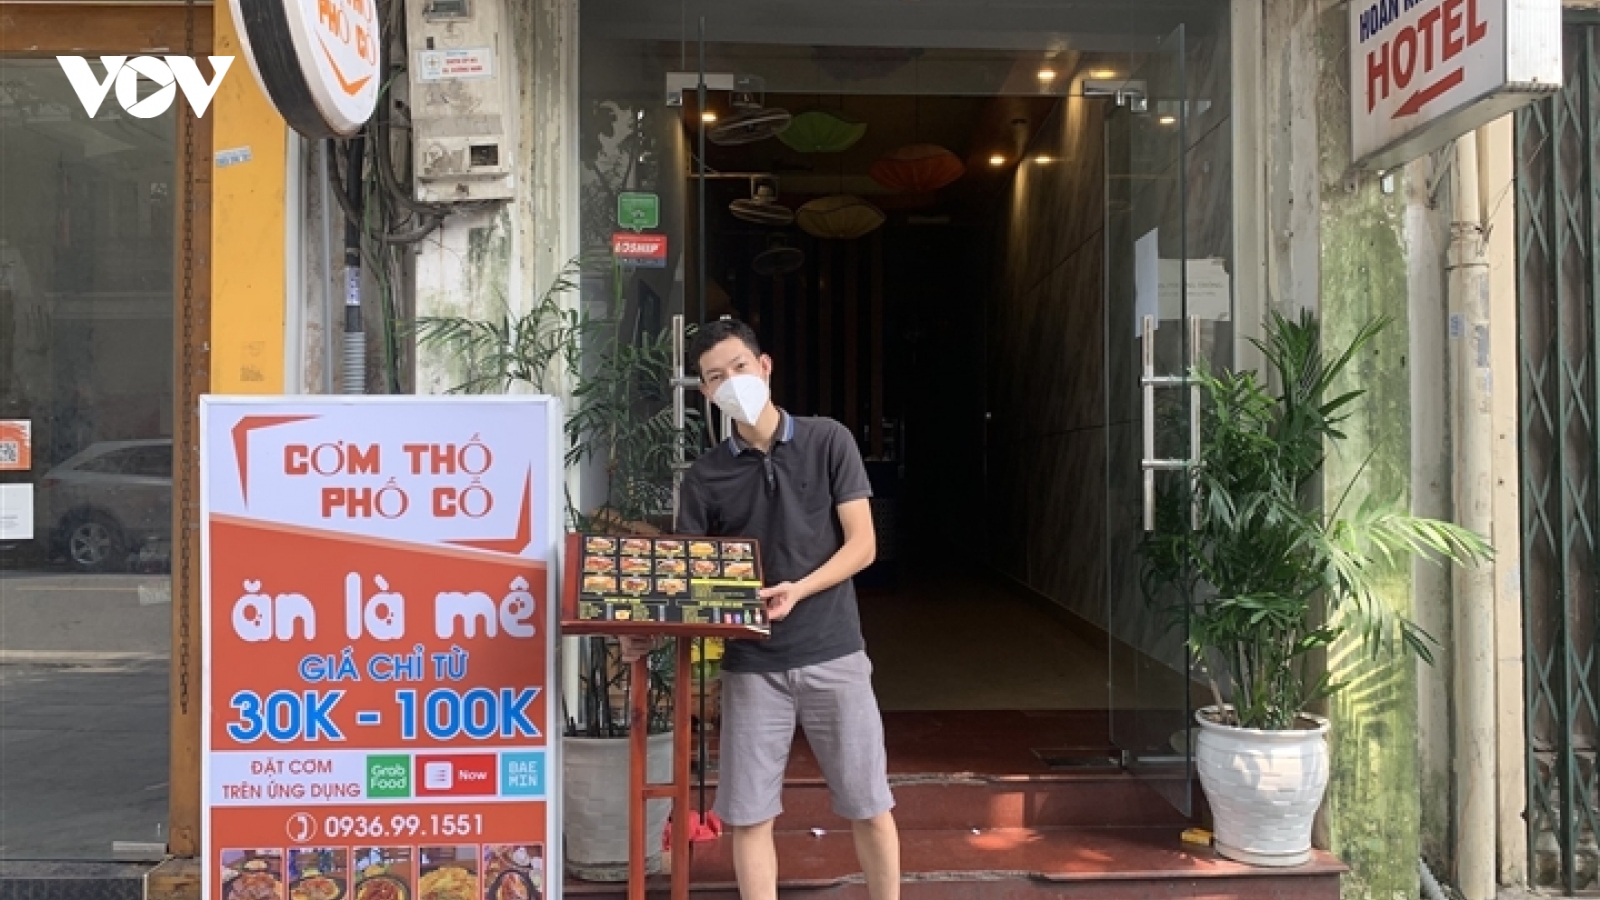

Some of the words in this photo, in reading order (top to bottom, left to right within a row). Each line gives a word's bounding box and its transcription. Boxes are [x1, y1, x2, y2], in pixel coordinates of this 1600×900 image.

[1367, 0, 1487, 115] HOTEL
[284, 439, 380, 476] CƠM
[403, 432, 494, 475] THỐ
[321, 476, 409, 518] PHỐ
[232, 578, 316, 641] ăn
[345, 572, 405, 640] là
[435, 575, 536, 639] mê
[299, 645, 361, 682] GIÁ
[367, 643, 425, 682] CHỈ
[431, 645, 469, 681] TỪ
[226, 690, 347, 742] 30K
[395, 687, 543, 740] 100K
[251, 757, 284, 778] ĐẶT
[289, 758, 332, 775] CƠM
[371, 764, 406, 777] Grab
[458, 769, 487, 781] Now
[508, 761, 538, 773] BAE
[222, 781, 262, 799] TRÊN
[267, 780, 305, 799] ỨNG
[311, 782, 361, 801] DỤNG
[371, 777, 407, 790] Food
[508, 774, 538, 787] MIN
[324, 813, 483, 838] 0936.99.1551
